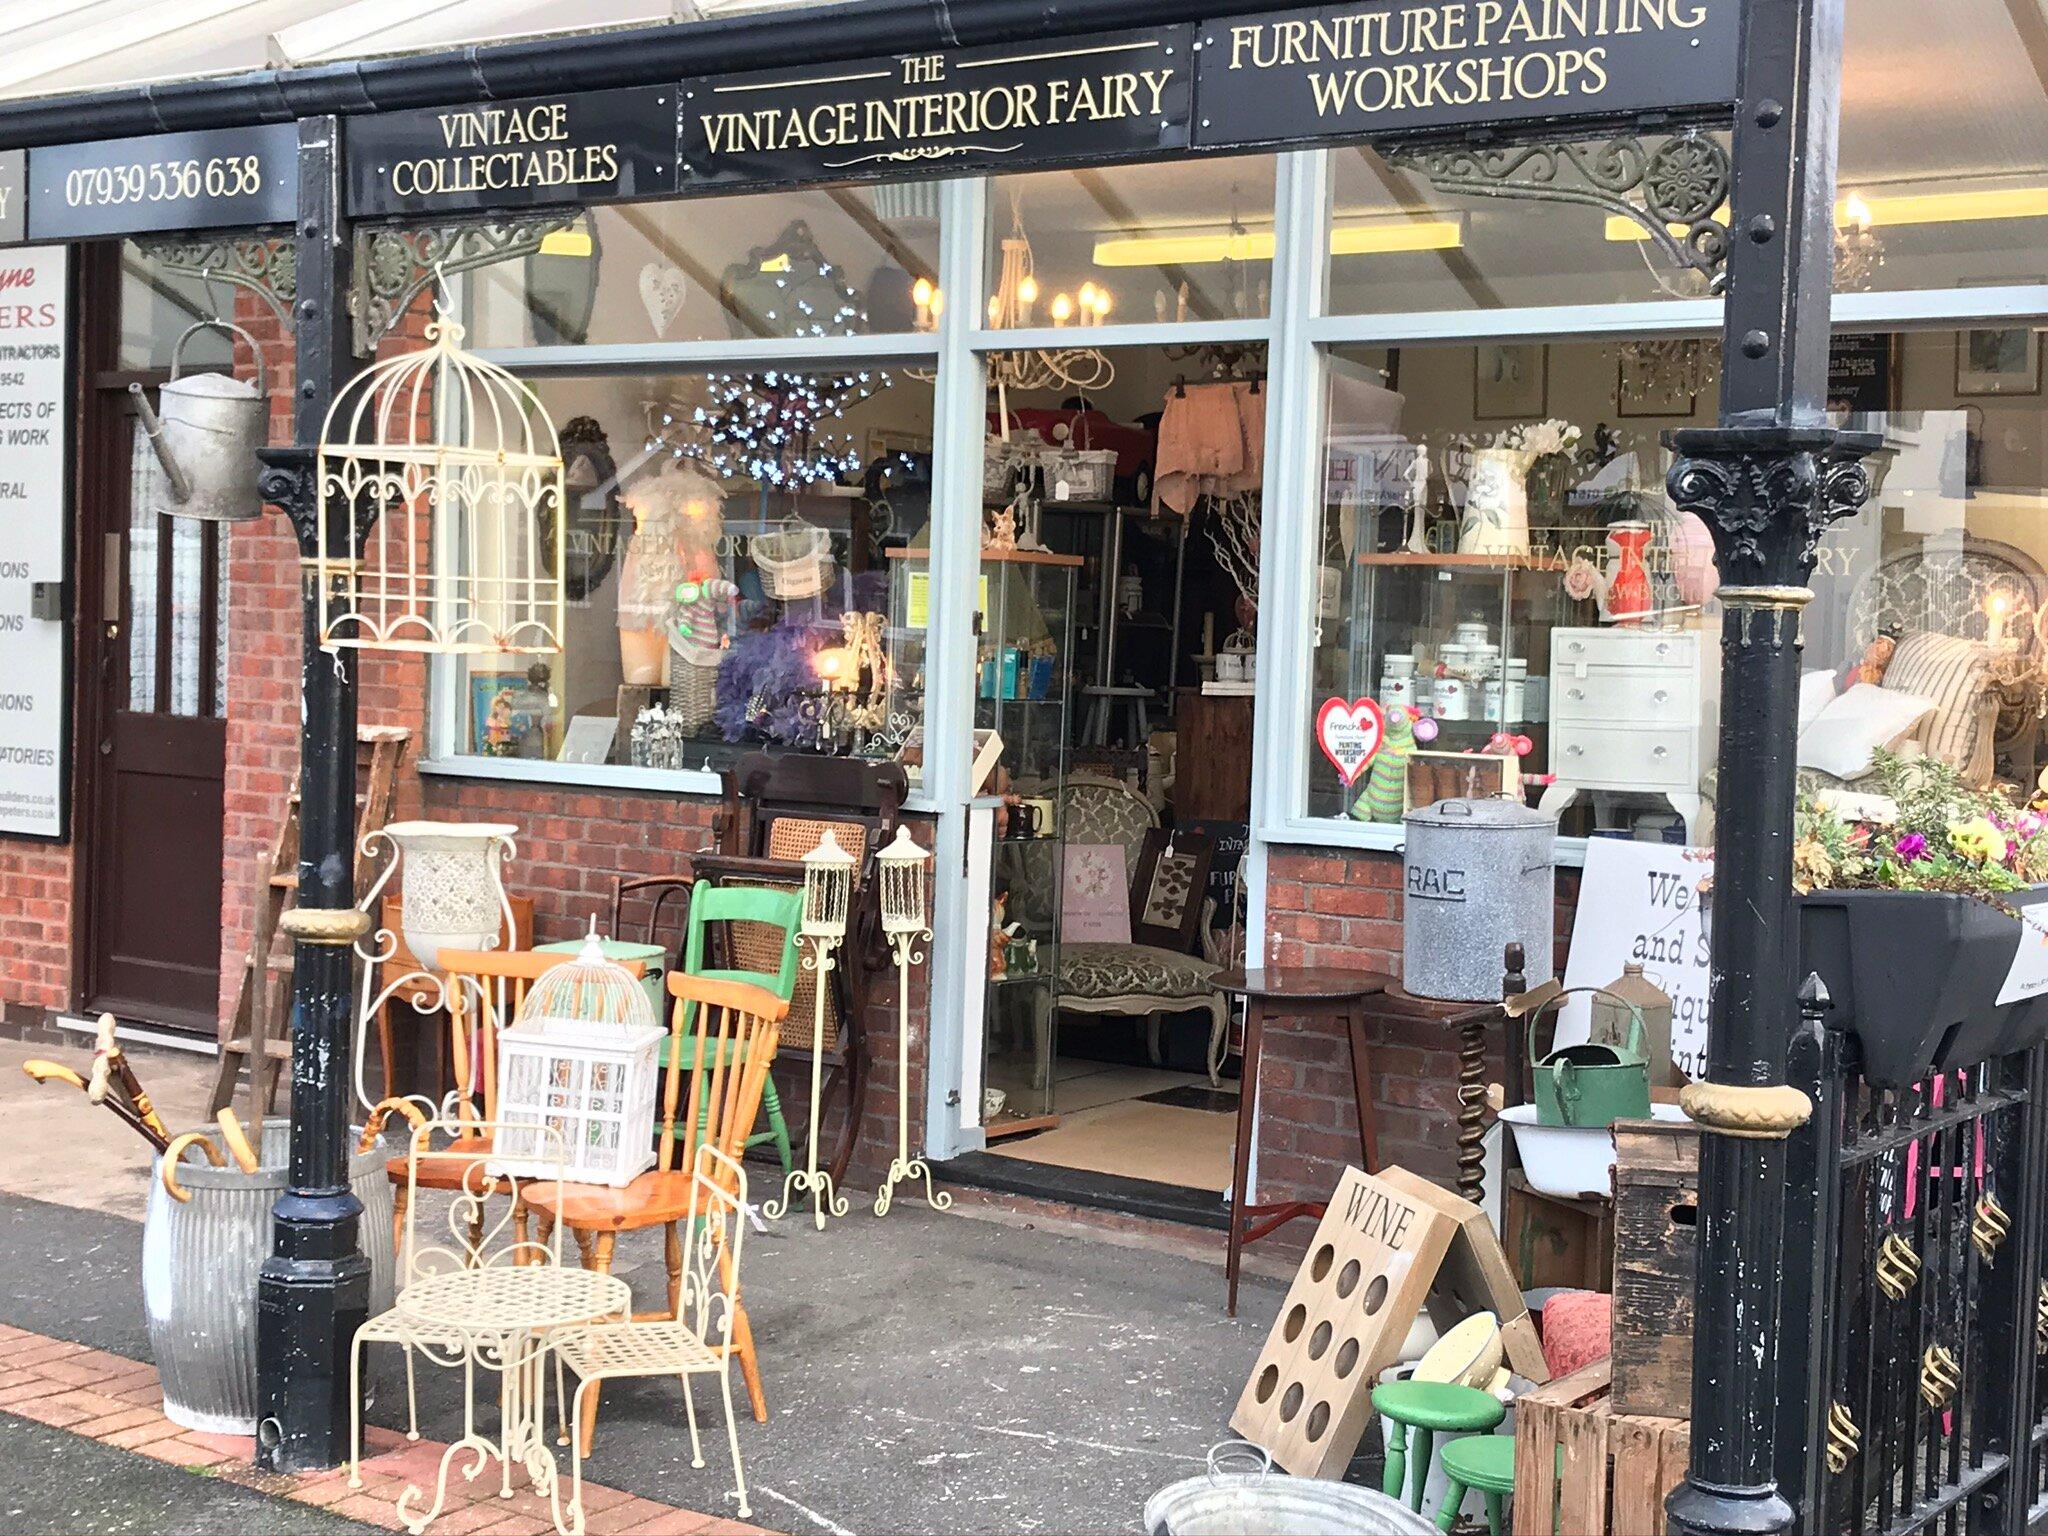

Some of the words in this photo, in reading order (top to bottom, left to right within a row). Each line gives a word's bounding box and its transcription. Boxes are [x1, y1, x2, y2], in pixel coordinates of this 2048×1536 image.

[1228, 5, 1469, 70] FURNITURE
[1472, 0, 1708, 47] PAINTING
[900, 54, 946, 85] THE
[1307, 46, 1608, 118] WORKSHOPS
[438, 103, 569, 149] VINTAGE
[699, 100, 860, 154] VINTAGE
[863, 83, 1041, 140] INTERIOR
[1045, 68, 1175, 125] FAIRY
[65, 164, 146, 207] 07939
[147, 158, 201, 201] 536
[205, 154, 262, 198] 638
[391, 144, 619, 197] COLLECTABLES
[37, 401, 56, 419] OF
[8, 428, 50, 446] WORK
[1482, 543, 1611, 572] VINTAGE
[1407, 865, 1466, 897] RAC
[1647, 870, 1689, 911] We
[1632, 928, 1685, 965] and
[1343, 1181, 1417, 1252] WINE
